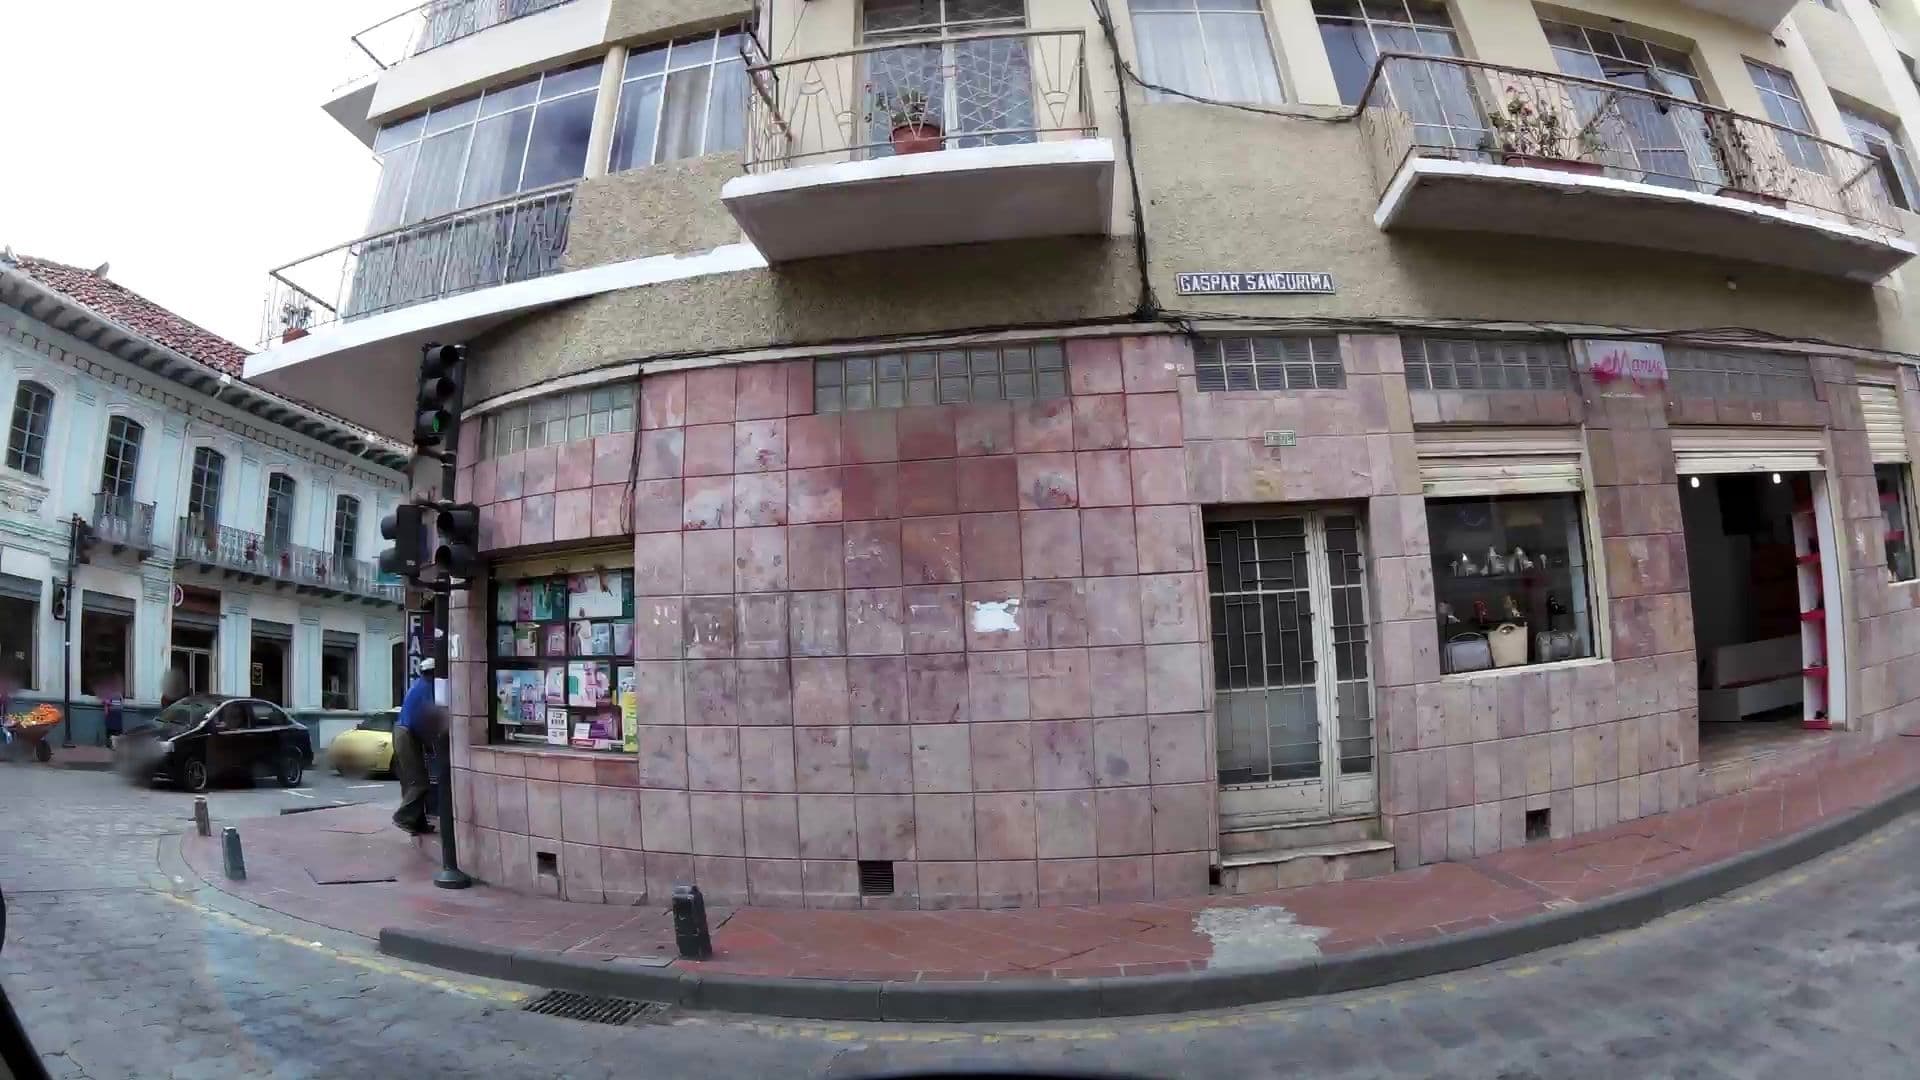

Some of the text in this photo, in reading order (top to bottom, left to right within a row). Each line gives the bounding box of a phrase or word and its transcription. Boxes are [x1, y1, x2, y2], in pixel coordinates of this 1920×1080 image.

[1180, 273, 1332, 292] GASPAR SANGURIMA
[409, 615, 422, 688] FAR
